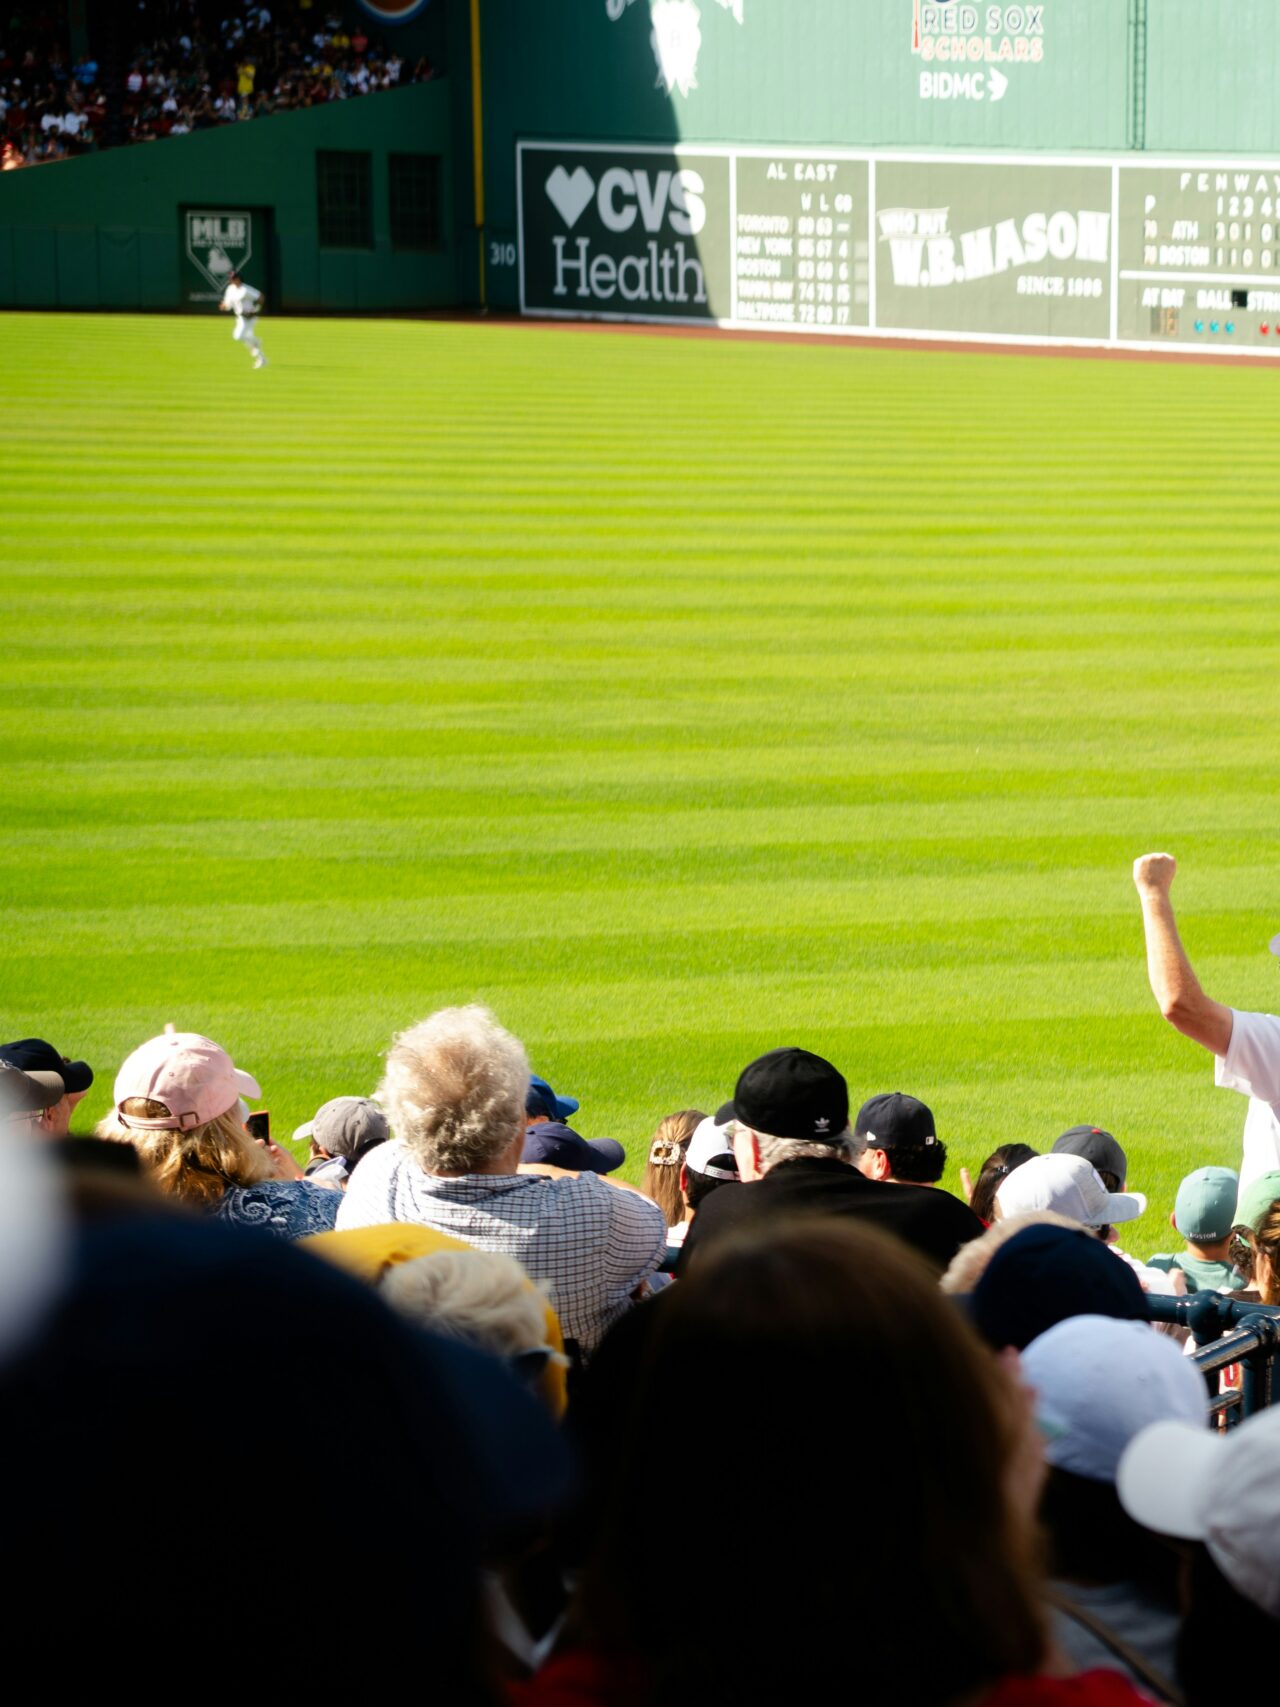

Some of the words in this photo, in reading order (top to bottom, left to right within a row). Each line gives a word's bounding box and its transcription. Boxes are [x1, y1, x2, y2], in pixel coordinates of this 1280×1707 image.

[922, 7, 977, 34] RED
[986, 6, 1044, 33] SOX
[921, 37, 1044, 62] SCHOLARS
[919, 71, 985, 99] BIDMC
[767, 162, 787, 180] AL
[794, 163, 837, 182] EAST
[598, 167, 706, 235] CVS
[801, 193, 812, 211] W
[820, 193, 829, 212] L
[834, 193, 852, 213] GB
[1145, 194, 1156, 214] P
[1217, 195, 1223, 216] 1
[1229, 196, 1239, 217] 2
[1243, 196, 1254, 217] 3
[1261, 197, 1272, 217] 4
[193, 218, 246, 240] MLB
[737, 214, 789, 234] TORONTO
[1172, 220, 1199, 240] ATH
[1229, 222, 1240, 241] 0
[1245, 222, 1251, 242] 1
[1261, 223, 1272, 243] 0
[490, 243, 516, 266] 310
[737, 236, 761, 255] NEW
[764, 237, 793, 256] YORK
[839, 239, 848, 259] 4
[1159, 245, 1210, 267] BOSTON
[1217, 247, 1223, 267] 1
[1231, 247, 1237, 268] 1
[1243, 248, 1253, 268] 0
[1261, 249, 1272, 269] 0
[553, 236, 706, 302] Health
[737, 258, 781, 277] BOSTON
[839, 262, 848, 281] 6
[799, 282, 815, 301] 74
[1017, 276, 1064, 296] SINCE
[1142, 288, 1160, 307] AT
[1162, 289, 1185, 308] BAT
[1197, 290, 1232, 310] BALL
[737, 301, 795, 321] BALTIMORE
[799, 304, 815, 323] 72
[836, 306, 849, 324] 17
